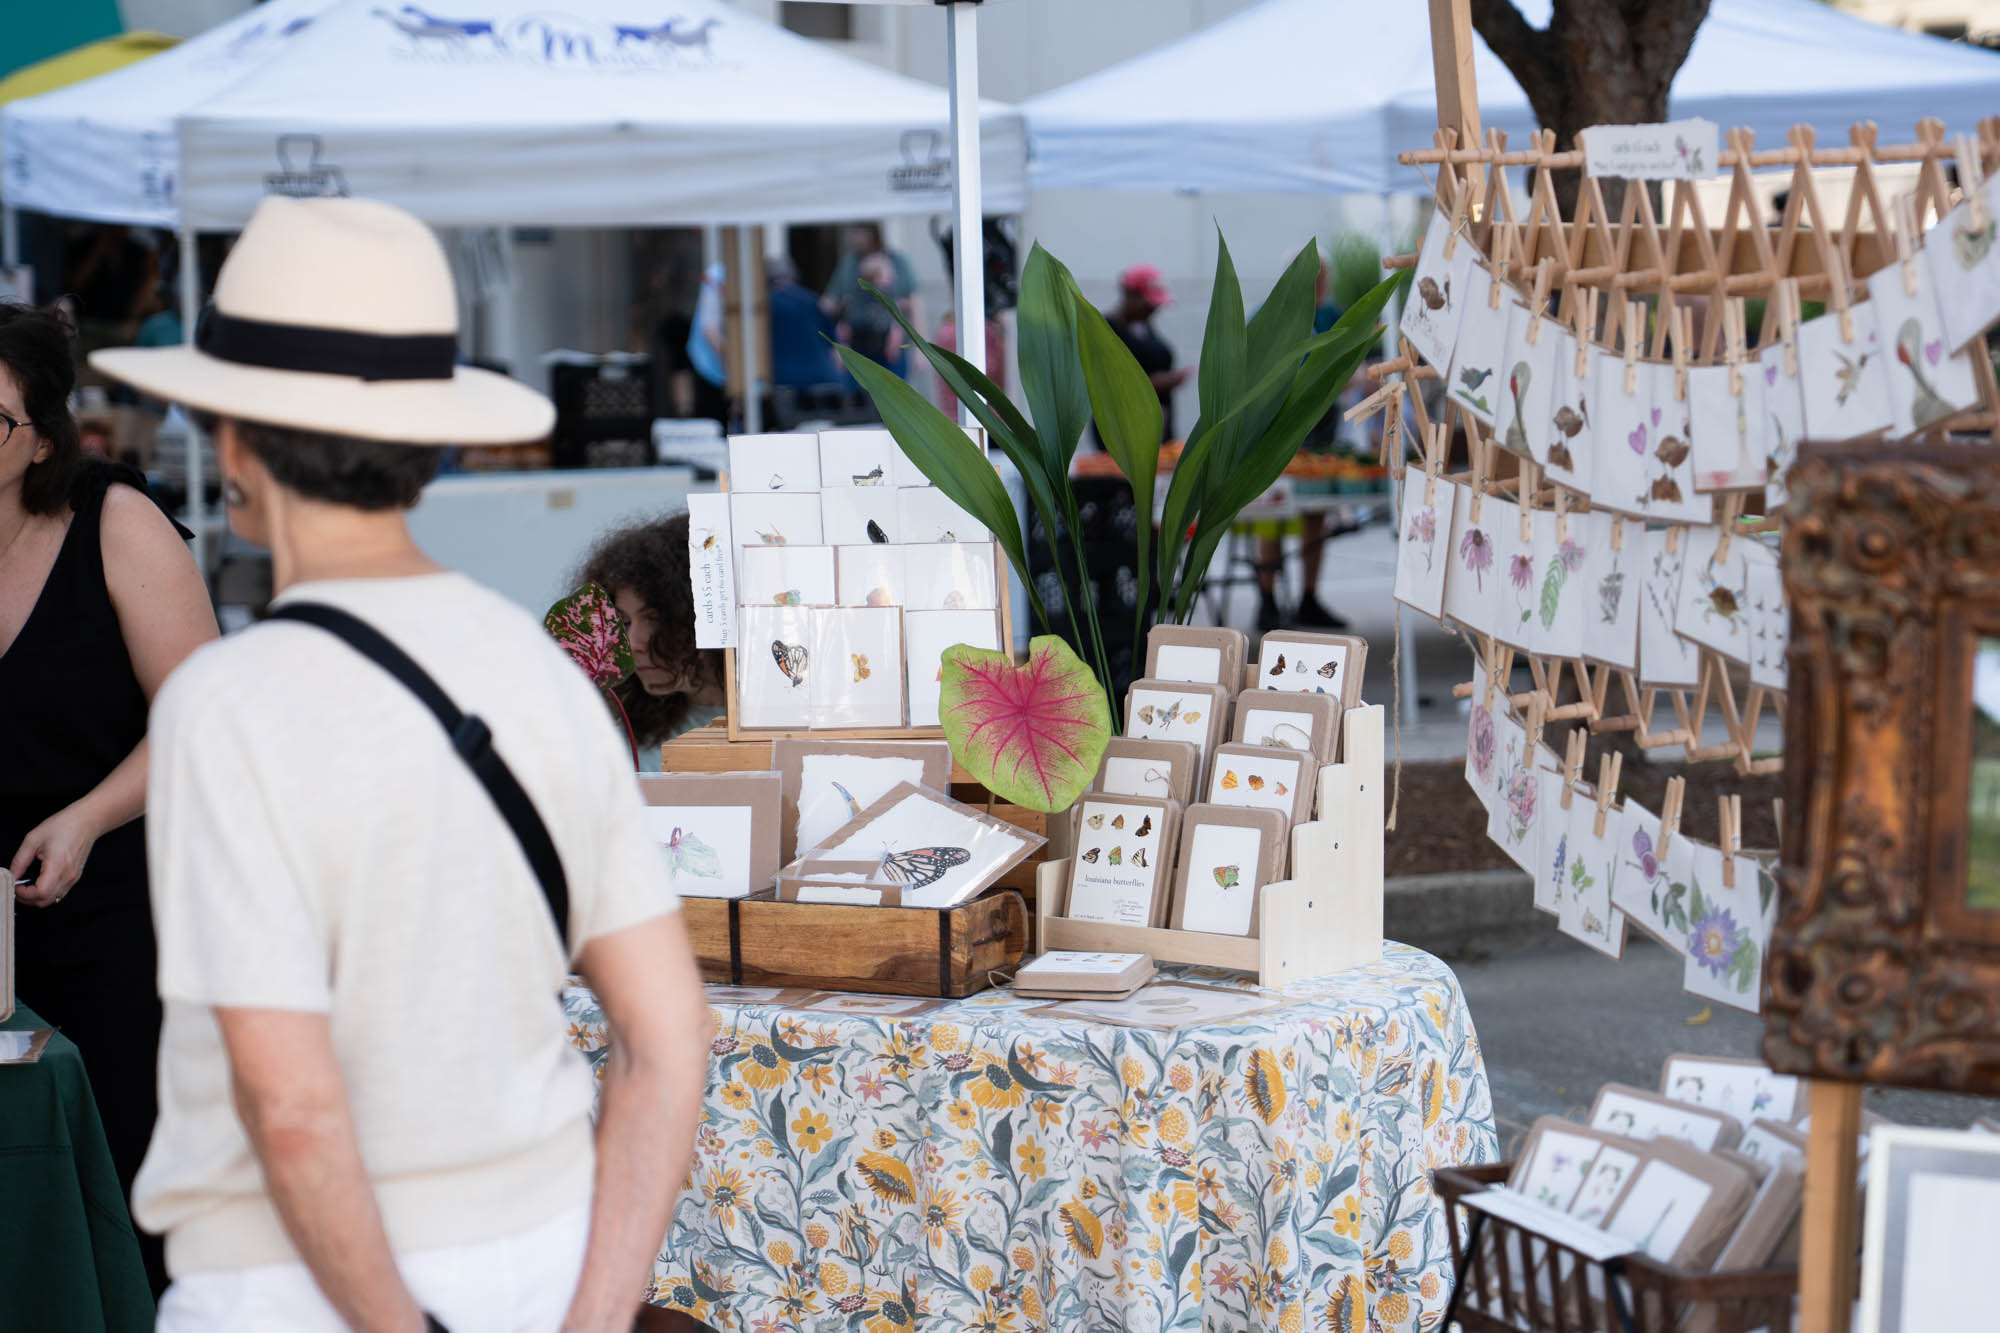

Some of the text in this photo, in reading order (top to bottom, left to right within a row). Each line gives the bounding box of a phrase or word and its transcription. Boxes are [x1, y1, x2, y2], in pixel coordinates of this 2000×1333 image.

[700, 563, 713, 624] cards $5 each
[1084, 873, 1145, 888] louisiana butterflies
